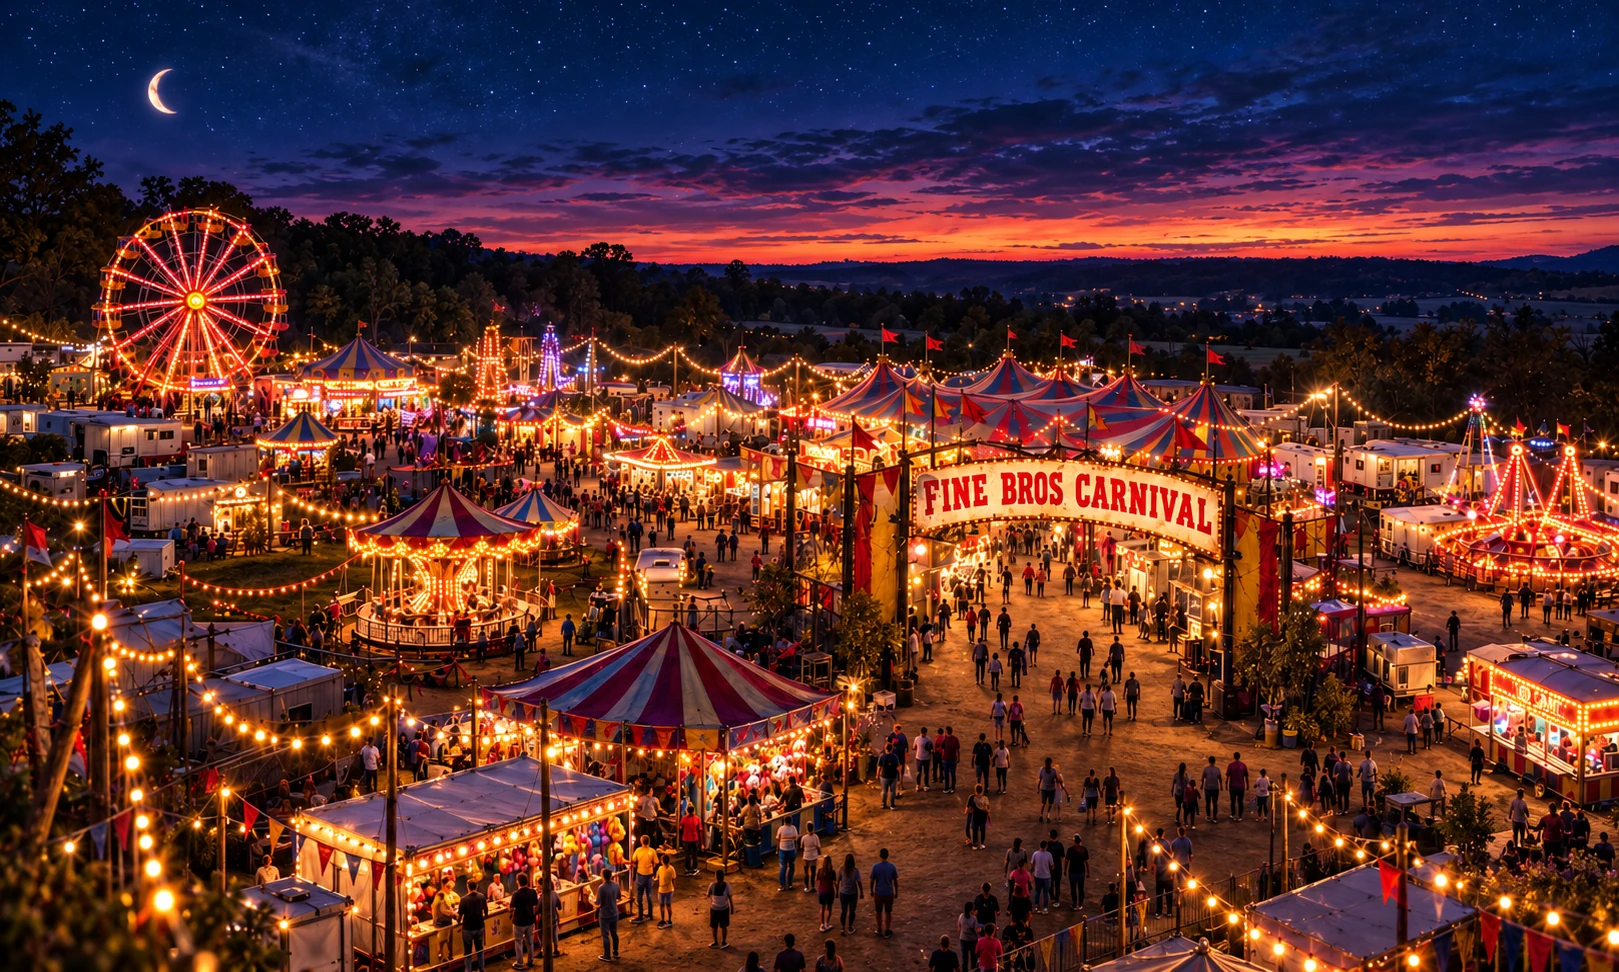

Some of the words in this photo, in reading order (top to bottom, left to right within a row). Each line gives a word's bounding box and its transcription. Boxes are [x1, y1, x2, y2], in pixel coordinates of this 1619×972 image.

[923, 473, 988, 516] FINE
[1001, 471, 1063, 505] BROS
[1075, 473, 1212, 535] CARNIVAL
